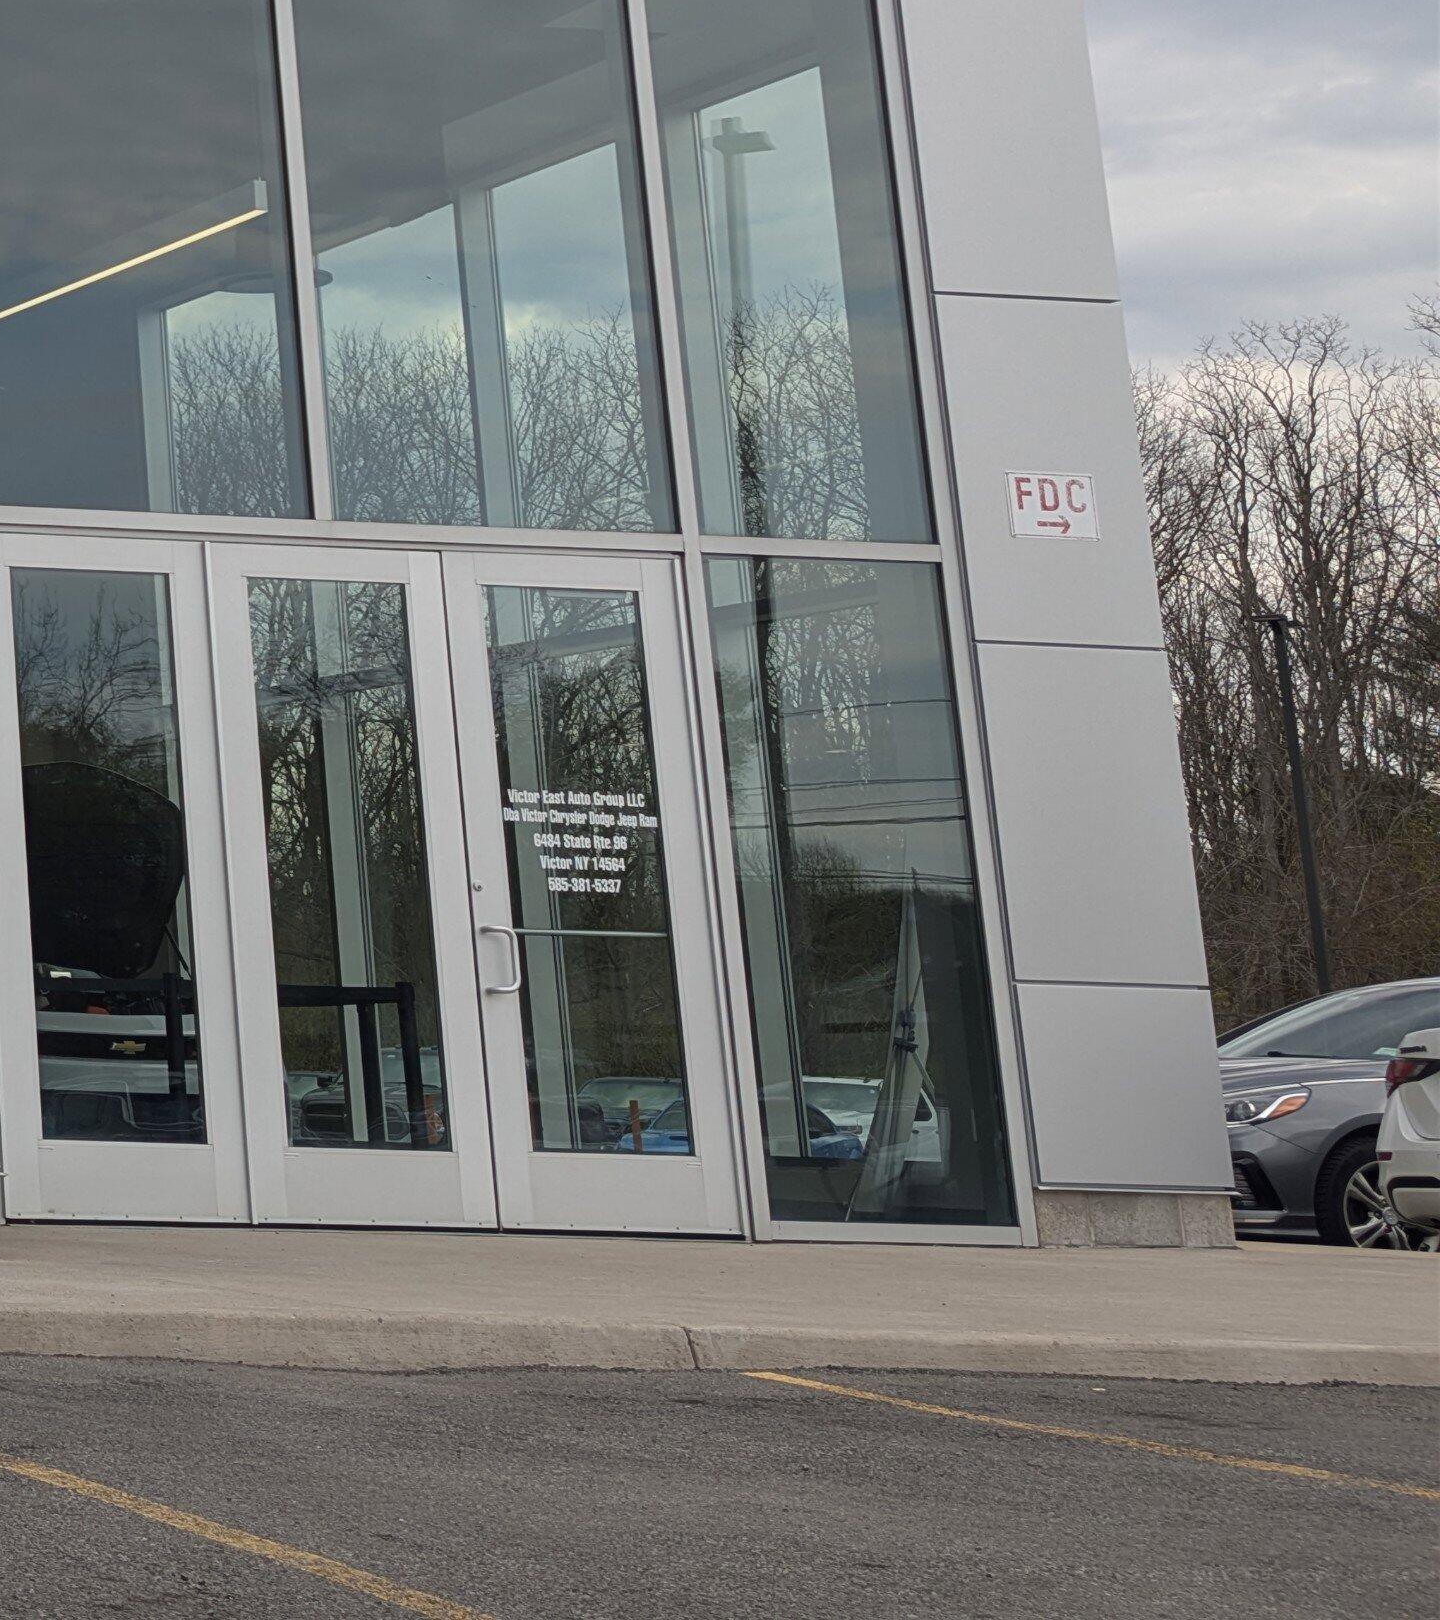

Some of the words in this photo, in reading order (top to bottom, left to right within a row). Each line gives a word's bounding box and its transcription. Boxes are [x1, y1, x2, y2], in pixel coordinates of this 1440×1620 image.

[1014, 476, 1087, 513] FDC
[507, 789, 540, 803] Victor
[542, 790, 566, 804] East
[568, 791, 591, 806] Auto
[593, 792, 624, 808] Group
[627, 793, 645, 807] LLC
[503, 807, 520, 822] Dba
[522, 808, 548, 823] Victor
[549, 809, 587, 826] Chrysler
[589, 812, 615, 826] Dodge
[617, 813, 637, 829] Jeep
[639, 813, 658, 828] Ram
[533, 833, 561, 847] 6484
[564, 834, 591, 848] State
[540, 855, 573, 870] Victor
[575, 856, 589, 870] NY
[593, 857, 626, 872] 14564
[548, 877, 622, 893] 585-381-5337
